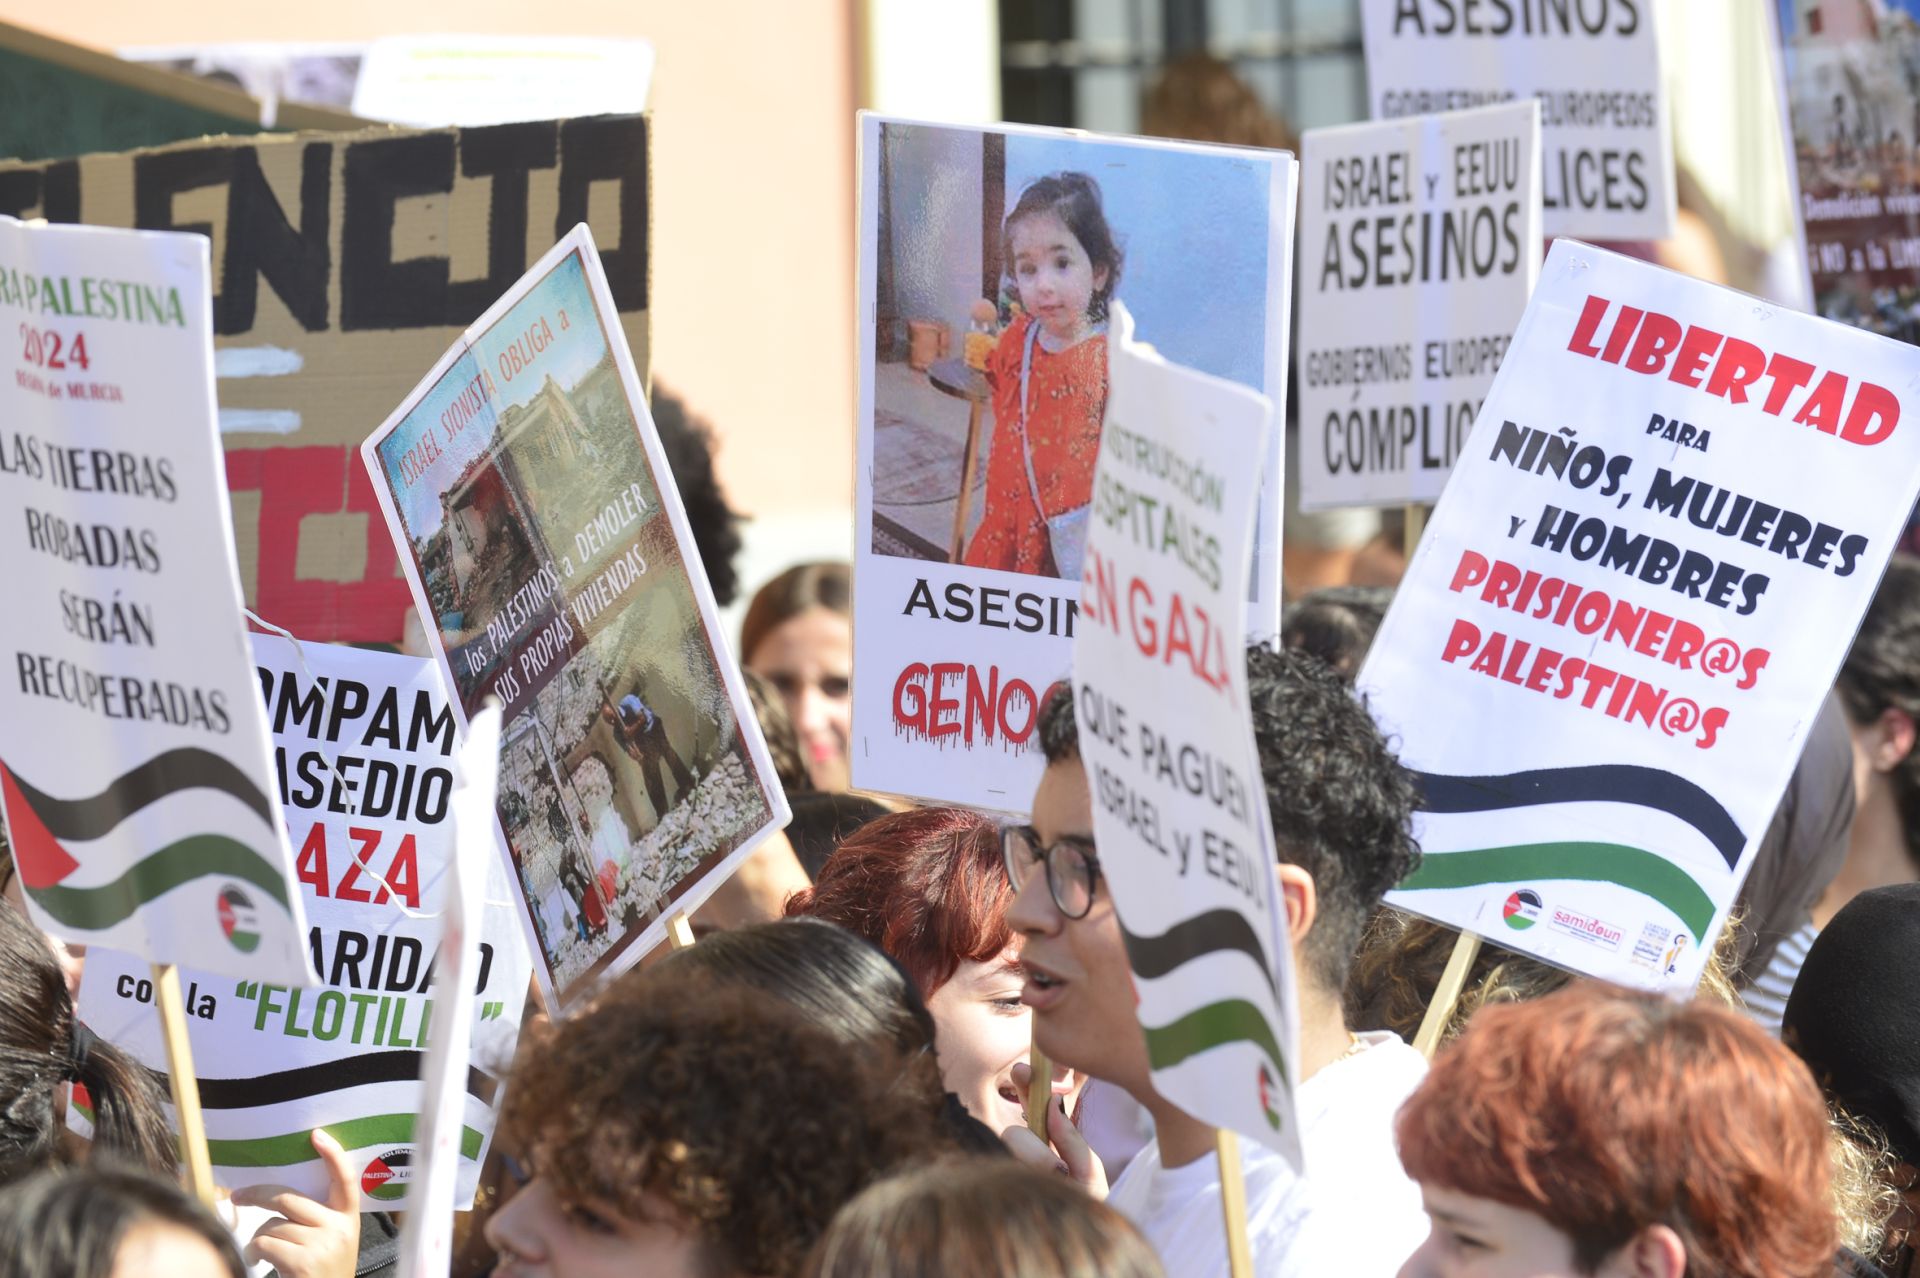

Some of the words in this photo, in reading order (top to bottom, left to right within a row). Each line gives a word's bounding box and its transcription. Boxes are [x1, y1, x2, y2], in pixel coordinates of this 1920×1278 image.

[1392, 0, 1640, 36] ASESINOS
[1323, 152, 1413, 210] ISRAEL
[1426, 174, 1440, 199] Y
[1454, 138, 1519, 197] EEUU
[1320, 202, 1520, 291] ASESINOS
[20, 323, 90, 371] 2024
[1306, 343, 1411, 388] GOBIERNOS
[1425, 335, 1511, 379] EUROPE
[1567, 294, 1900, 446] LIBERTAD
[399, 428, 443, 489] ISRAEL
[441, 369, 497, 443] SIONISTA
[498, 316, 554, 382] OBLIGA
[558, 309, 570, 331] a
[1646, 413, 1711, 452] PARA
[0, 431, 43, 480] LAS
[45, 441, 177, 502] TIERRAS
[1489, 420, 1633, 509] NIÑOS,
[1643, 467, 1869, 577] MUJERES
[25, 506, 161, 574] ROBADAS
[465, 649, 487, 677] los
[487, 559, 558, 653] PALESTINOS
[562, 556, 575, 578] a
[574, 483, 648, 563] DEMOLER
[1507, 516, 1527, 539] Y
[1530, 504, 1770, 616] HOMBRES
[60, 588, 155, 648] SERÁN
[494, 667, 520, 712] SUS
[519, 610, 574, 684] PROPIAS
[571, 544, 648, 628] VIVIENDAS
[1449, 549, 1771, 690] PRISIONER@S
[17, 652, 232, 735] RECUPERADAS
[893, 663, 1066, 757] GENO
[1081, 683, 1131, 758] QUE
[1441, 619, 1730, 749] PALESTIN@S
[1095, 762, 1169, 857] ISRAEL
[1173, 829, 1191, 878] y
[285, 821, 421, 909] AZA
[1554, 910, 1621, 942] samidoun
[117, 973, 159, 1007] co
[187, 982, 217, 1020] la
